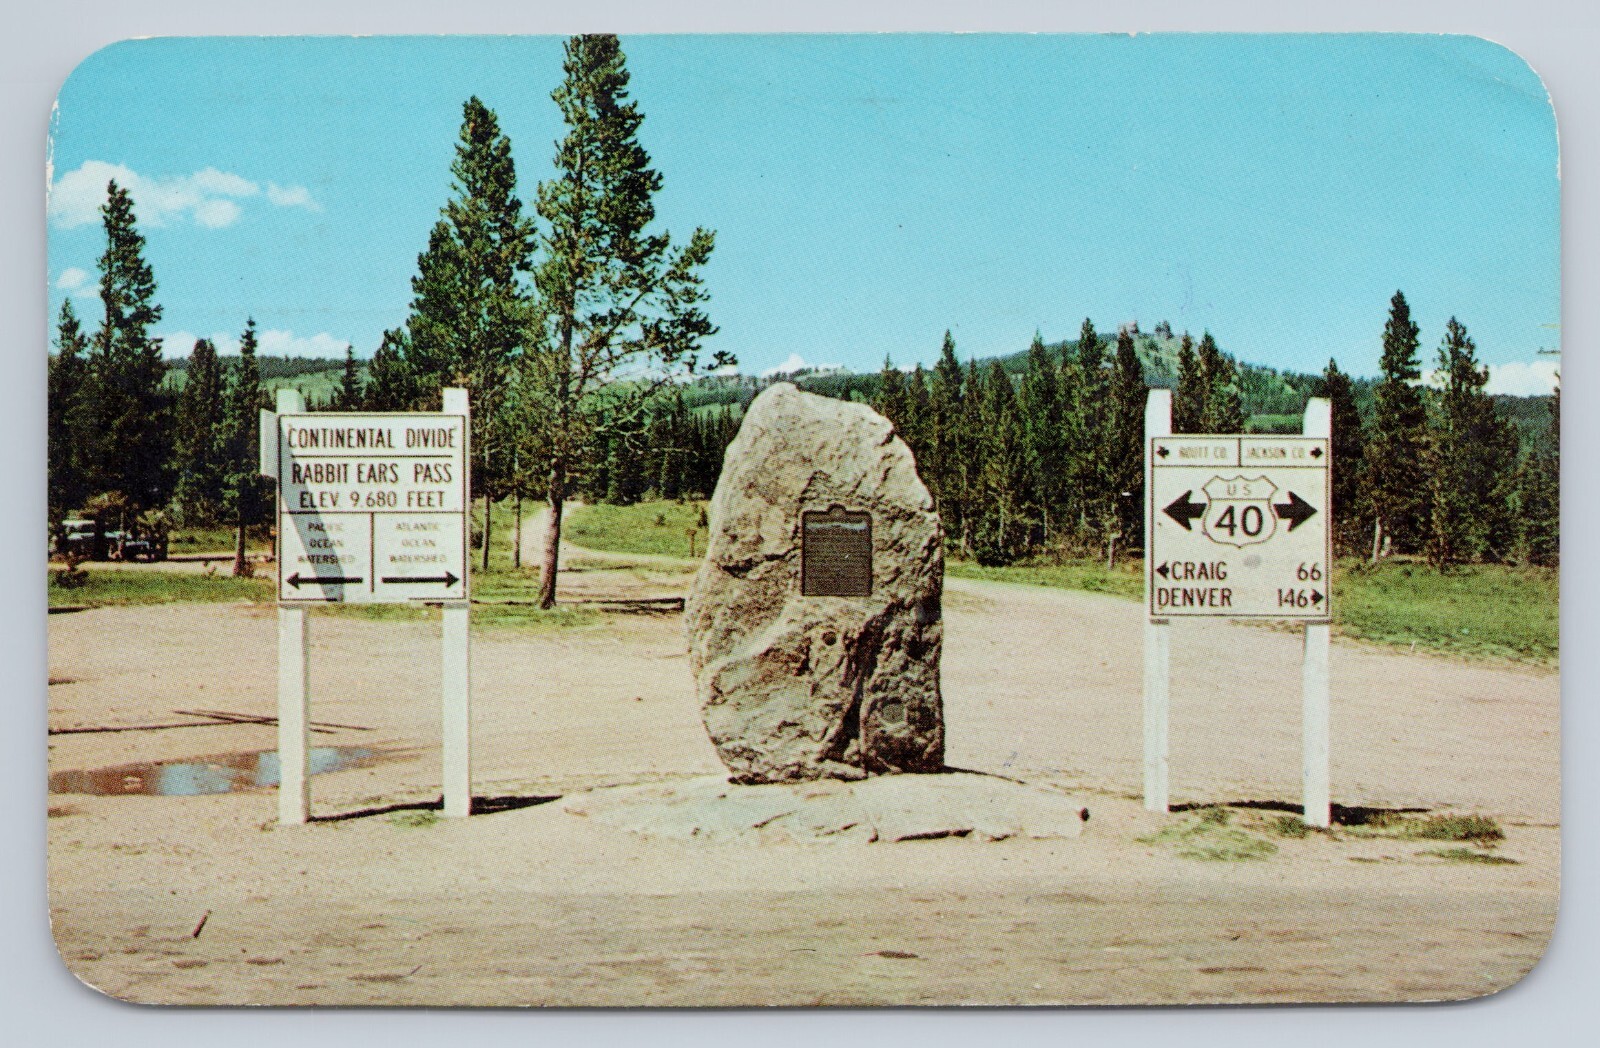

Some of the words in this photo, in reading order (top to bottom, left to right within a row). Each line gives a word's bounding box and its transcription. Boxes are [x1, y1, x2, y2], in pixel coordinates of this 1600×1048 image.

[288, 427, 395, 449] CONTINENTAL
[406, 427, 456, 449] DIVIDE
[291, 462, 349, 484] RABBIT
[357, 462, 399, 484] EARS
[414, 463, 452, 484] PASS
[406, 491, 446, 508] FEET
[1214, 504, 1264, 537] 40
[401, 538, 437, 548] OCEAN
[1171, 561, 1227, 580] CRAIG
[1297, 562, 1321, 581] 66
[1157, 587, 1232, 607] DENVER
[1277, 587, 1308, 607] 146
